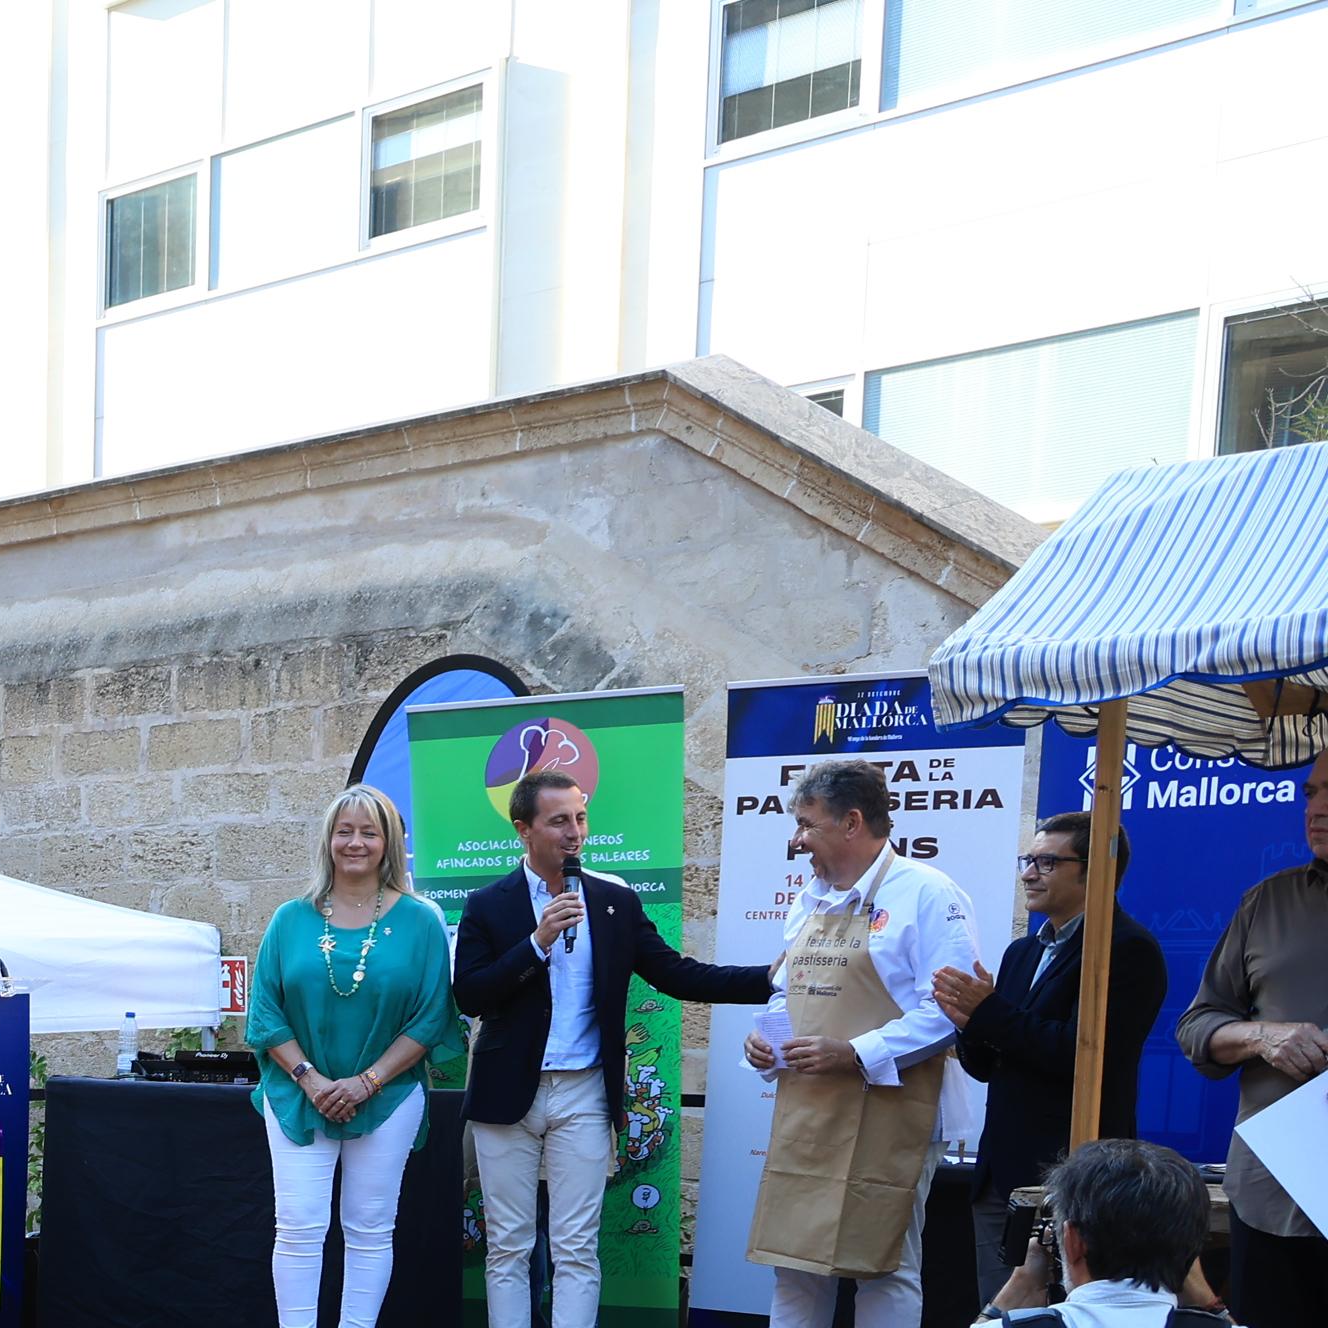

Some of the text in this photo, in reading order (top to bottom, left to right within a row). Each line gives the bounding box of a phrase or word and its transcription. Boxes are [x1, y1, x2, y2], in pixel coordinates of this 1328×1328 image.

[836, 700, 919, 718] DIADA DE
[834, 714, 928, 730] MALLORCA
[929, 758, 955, 768] DE
[928, 771, 954, 781] LA
[1147, 775, 1296, 809] Mallorca
[457, 836, 525, 852] ASOCIACIÓ
[436, 855, 502, 869] AFINCADOS
[591, 849, 650, 863] BALEARES
[785, 874, 804, 888] 14
[745, 910, 788, 921] CENTRE
[833, 935, 846, 948] de
[849, 936, 861, 949] la
[792, 954, 848, 968] pastisseria
